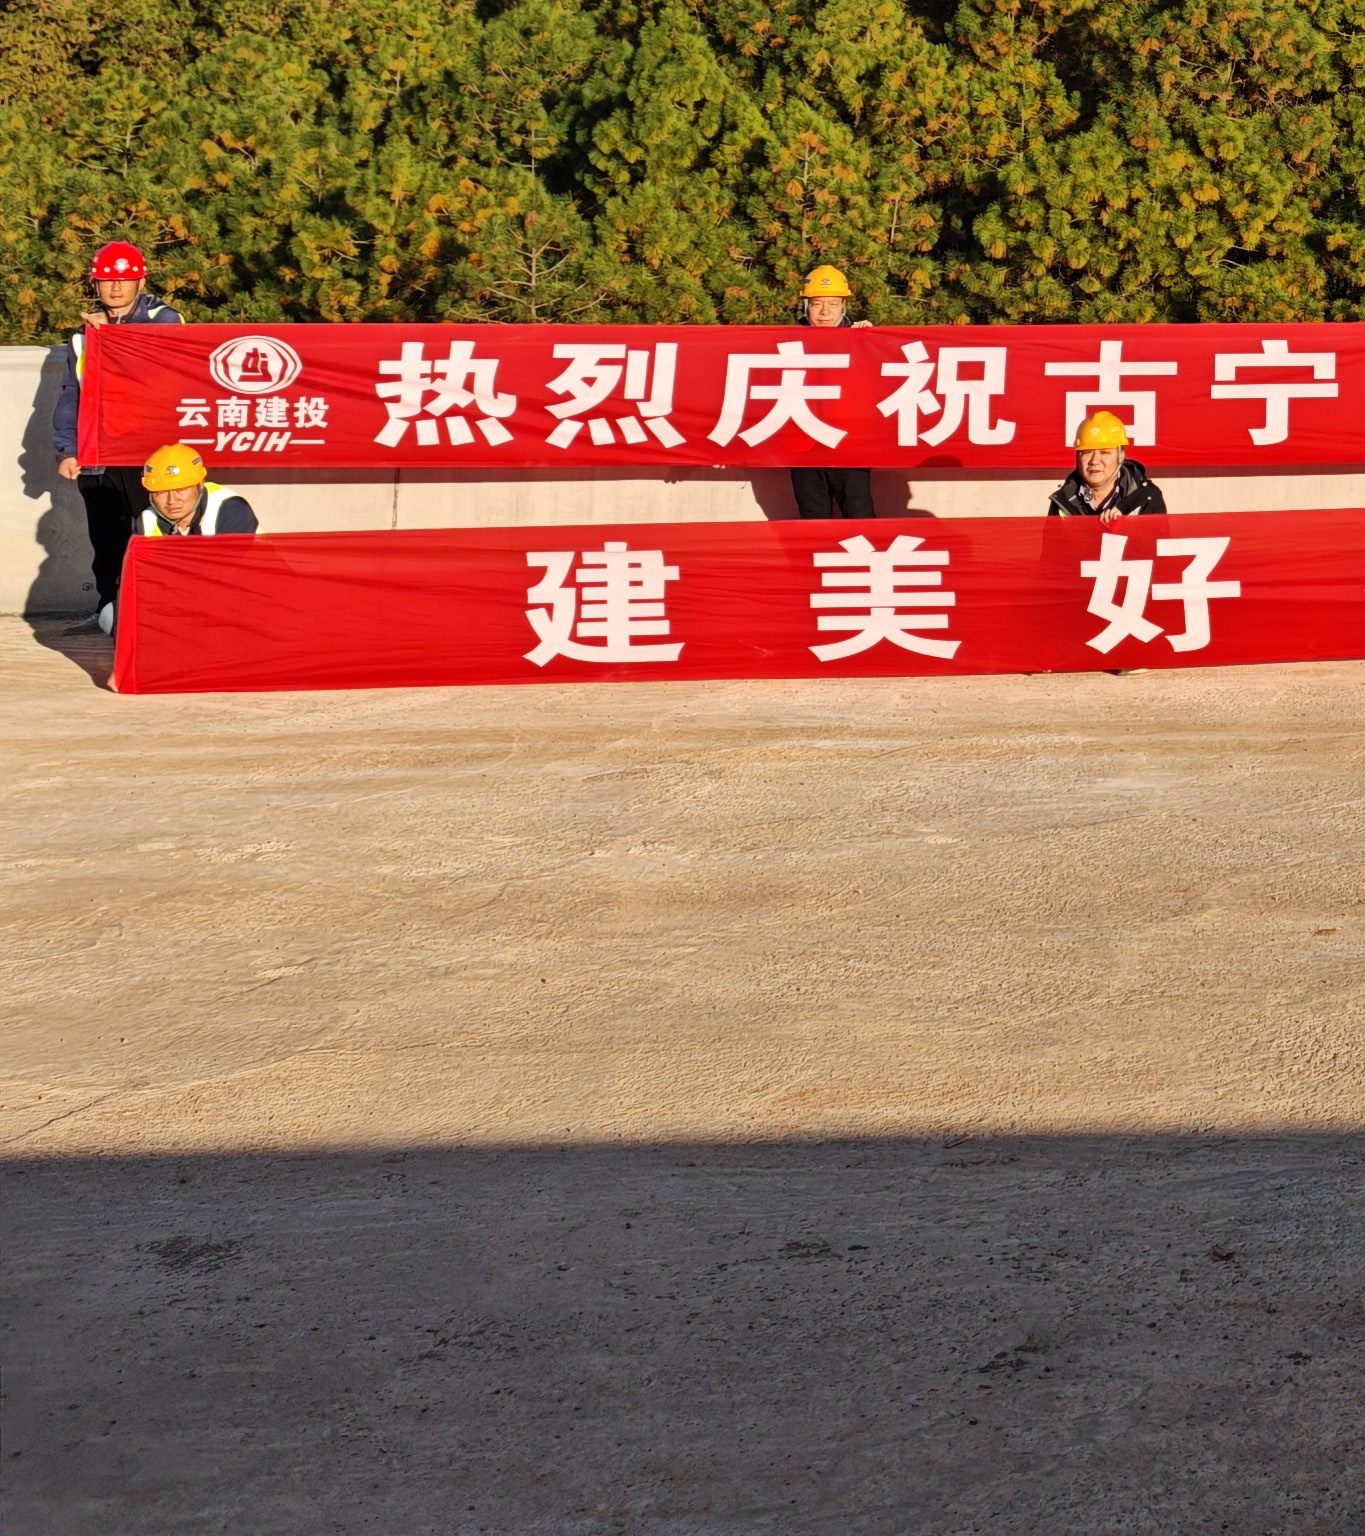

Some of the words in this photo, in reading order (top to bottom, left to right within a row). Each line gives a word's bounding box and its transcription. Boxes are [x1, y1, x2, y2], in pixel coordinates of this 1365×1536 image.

[175, 396, 329, 428] 云南建投
[214, 431, 292, 452] YCIH
